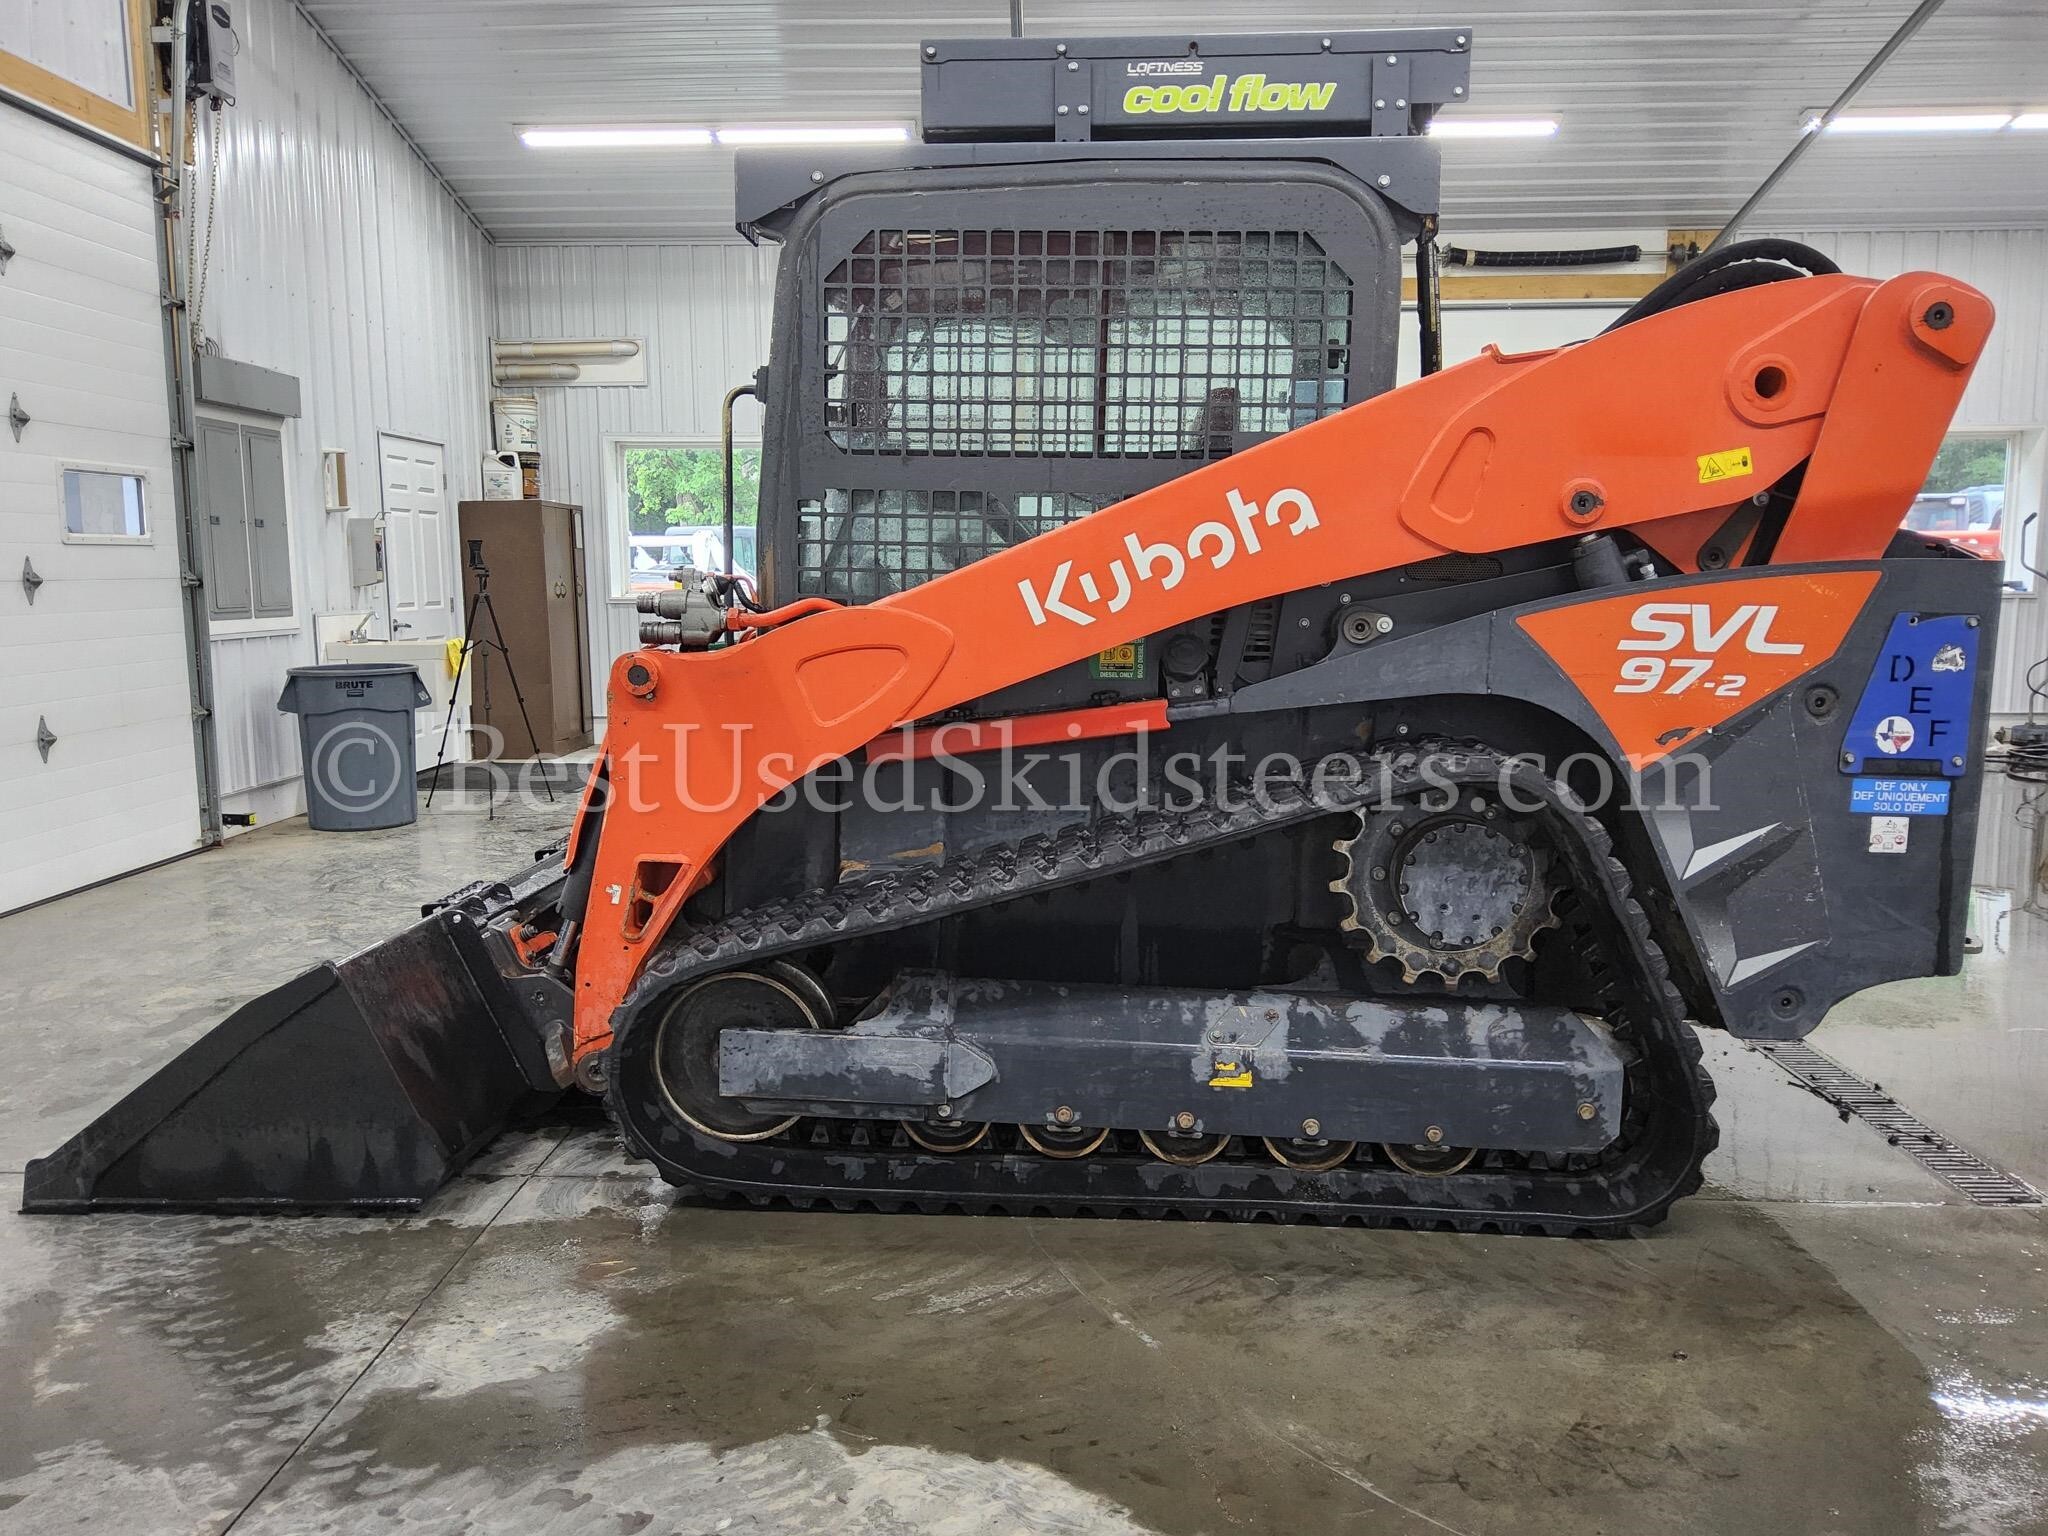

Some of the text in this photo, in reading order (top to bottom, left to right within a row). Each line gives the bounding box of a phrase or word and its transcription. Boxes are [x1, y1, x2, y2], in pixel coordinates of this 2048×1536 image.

[1126, 61, 1204, 76] LOFTNESS
[1123, 74, 1337, 114] cool flow
[1017, 488, 1320, 626] Kubota
[1616, 603, 1805, 655] SVL
[1613, 657, 1747, 697] 97-2
[335, 680, 374, 690] BRUTE
[1874, 781, 1928, 792] DEF ONLY
[1853, 791, 1948, 803] DEF UNIQUEMENT
[1873, 801, 1926, 812] SOLO DEF
